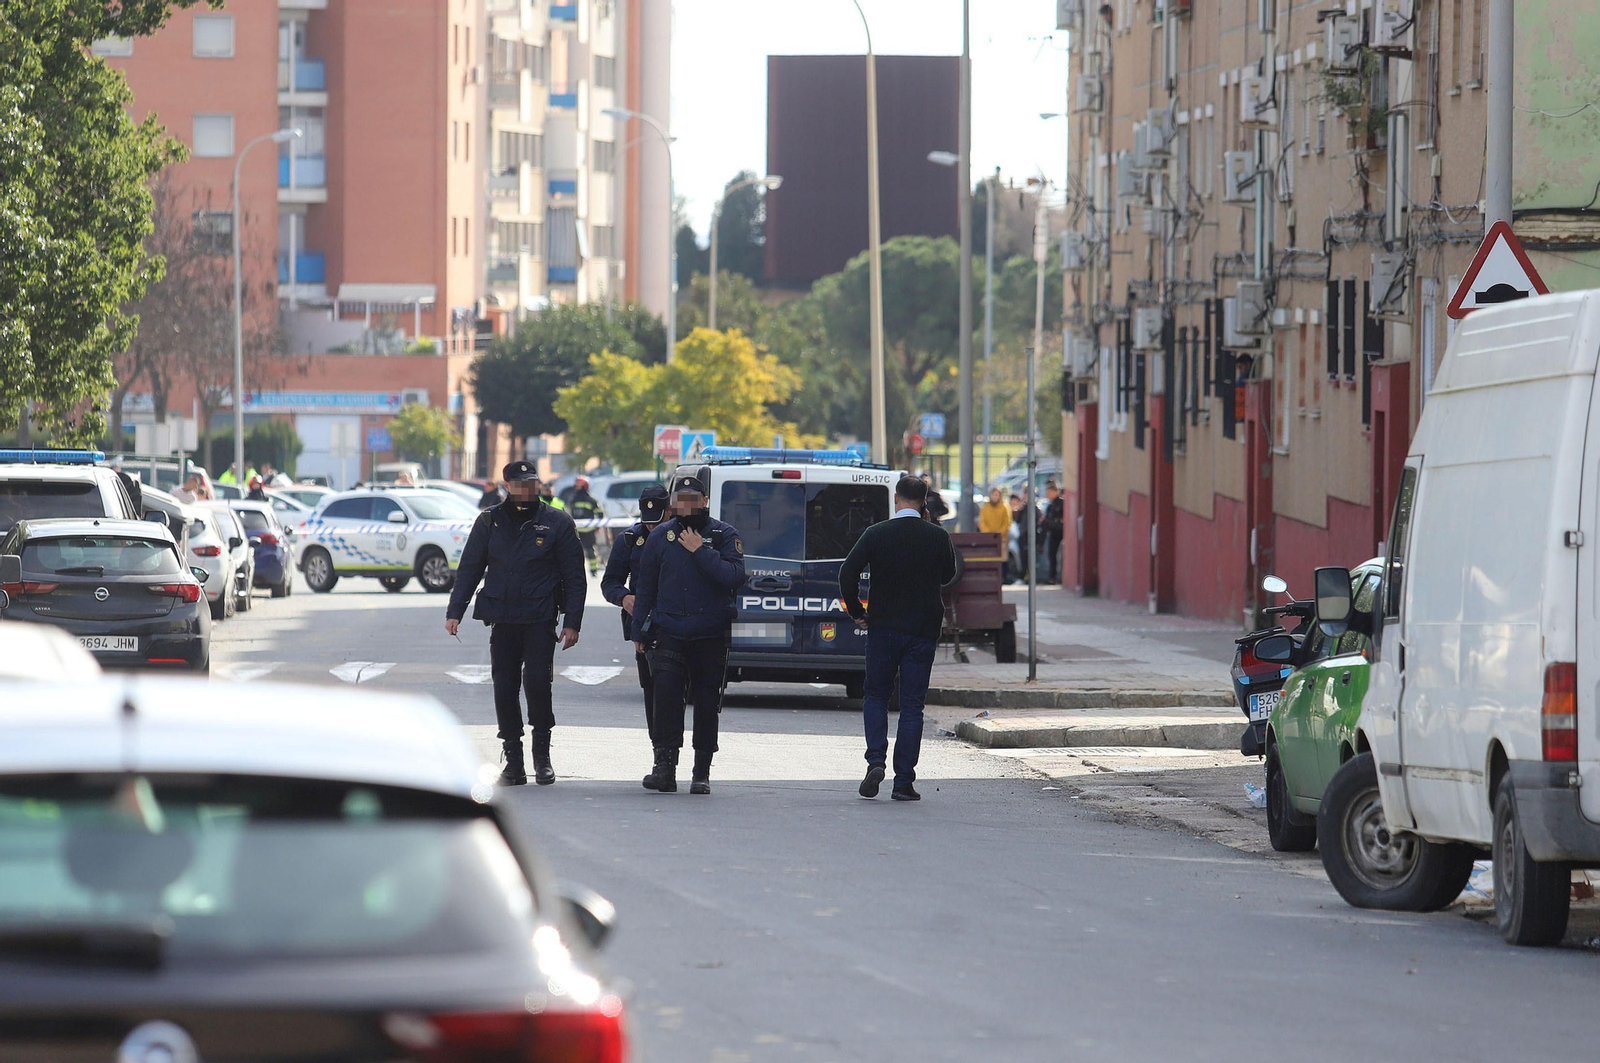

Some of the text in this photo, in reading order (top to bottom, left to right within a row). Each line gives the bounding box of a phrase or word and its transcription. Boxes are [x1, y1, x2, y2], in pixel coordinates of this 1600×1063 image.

[659, 440, 680, 450] STO
[852, 474, 890, 483] UPR-17C
[752, 569, 791, 577] TRAFIC
[113, 638, 135, 649] JHM
[1258, 692, 1279, 706] 526
[1259, 705, 1273, 718] FH
